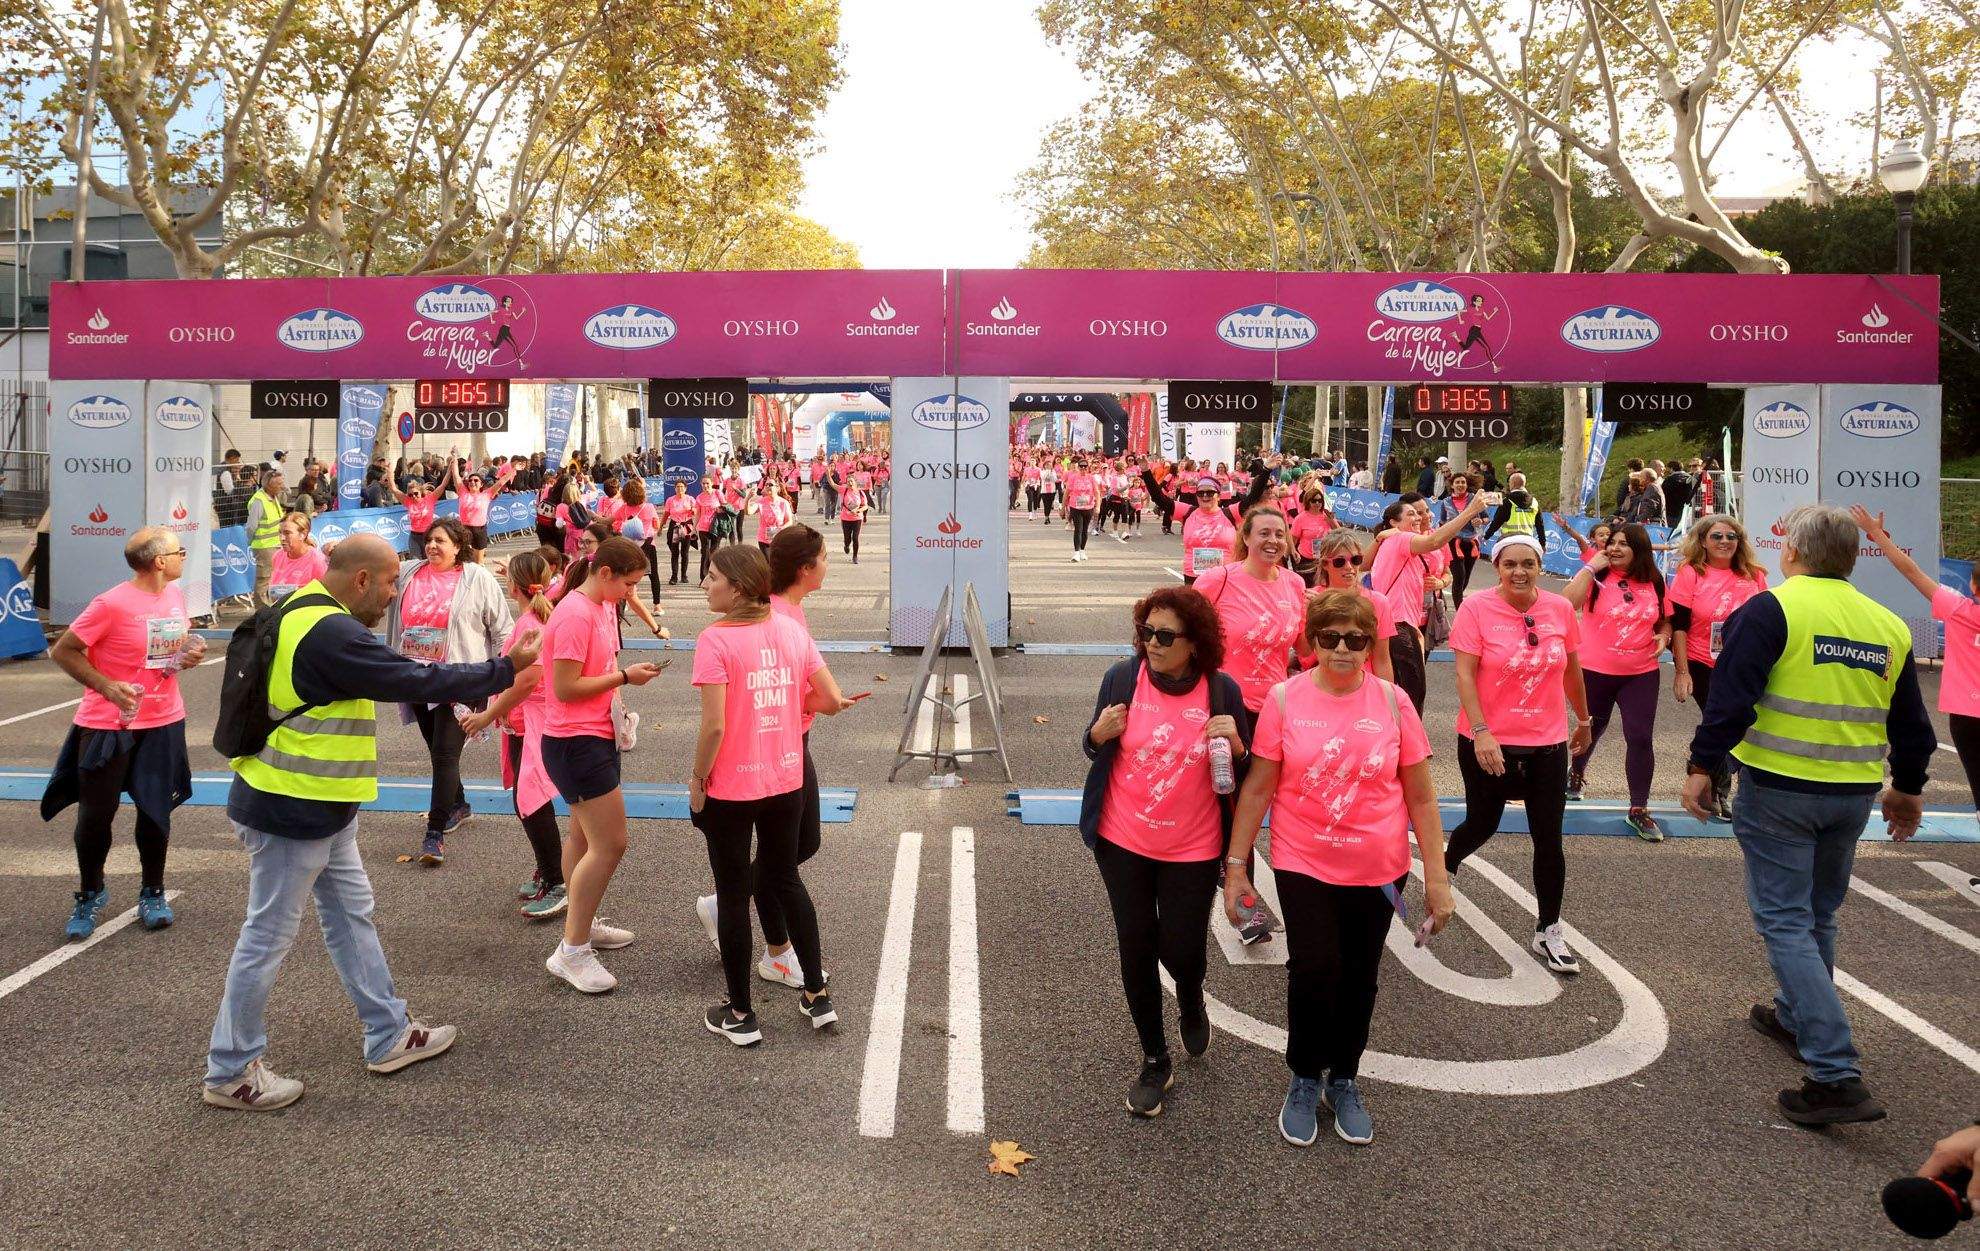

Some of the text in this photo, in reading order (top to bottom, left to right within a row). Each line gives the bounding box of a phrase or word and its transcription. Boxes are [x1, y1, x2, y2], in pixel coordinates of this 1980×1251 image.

[421, 298, 491, 313] ASTURIANA
[1382, 296, 1459, 312] ASTURIANA
[169, 327, 235, 342] OYSHO
[283, 325, 357, 341] ASTURIANA
[407, 320, 474, 342] Carrera
[590, 321, 670, 338] ASTURIANA
[723, 320, 799, 337] OYSHO
[846, 323, 920, 336] Santander
[966, 322, 1041, 336] Santander
[1089, 319, 1168, 337] OYSHO
[1224, 320, 1310, 339] ASTURIANA
[1367, 319, 1442, 343] Carrera
[1569, 323, 1654, 340] ASTURIANA
[1709, 324, 1789, 342] OYSHO
[67, 332, 129, 344] Santander
[1836, 330, 1914, 344] Santander
[423, 341, 500, 374] de la Mujer
[1385, 341, 1470, 377] de la Mujer
[265, 391, 328, 408] OYSHO
[664, 391, 735, 407] OYSHO
[1184, 393, 1258, 410] OYSHO
[1619, 394, 1693, 410] OYSHO
[72, 408, 127, 421] ASTURIANA
[158, 408, 201, 422] ASTURIANA
[419, 411, 505, 431] OYSHO
[917, 407, 984, 422] ASTURIANA
[1756, 415, 1806, 429] ASTURIANA
[1845, 414, 1914, 430] ASTURIANA
[1200, 428, 1232, 436] OYSHO
[1416, 418, 1509, 439] OYSHO
[64, 457, 132, 474] OYSHO
[155, 456, 205, 473] OYSHO
[908, 462, 991, 480] OYSHO
[1752, 466, 1809, 486] OYSHO
[1837, 470, 1920, 489] OYSHO
[70, 524, 127, 537] Santander
[915, 535, 984, 549] Santander
[760, 648, 777, 667] TU
[1814, 642, 1888, 665] VOLUNTARIS
[747, 667, 795, 690] DORSAL
